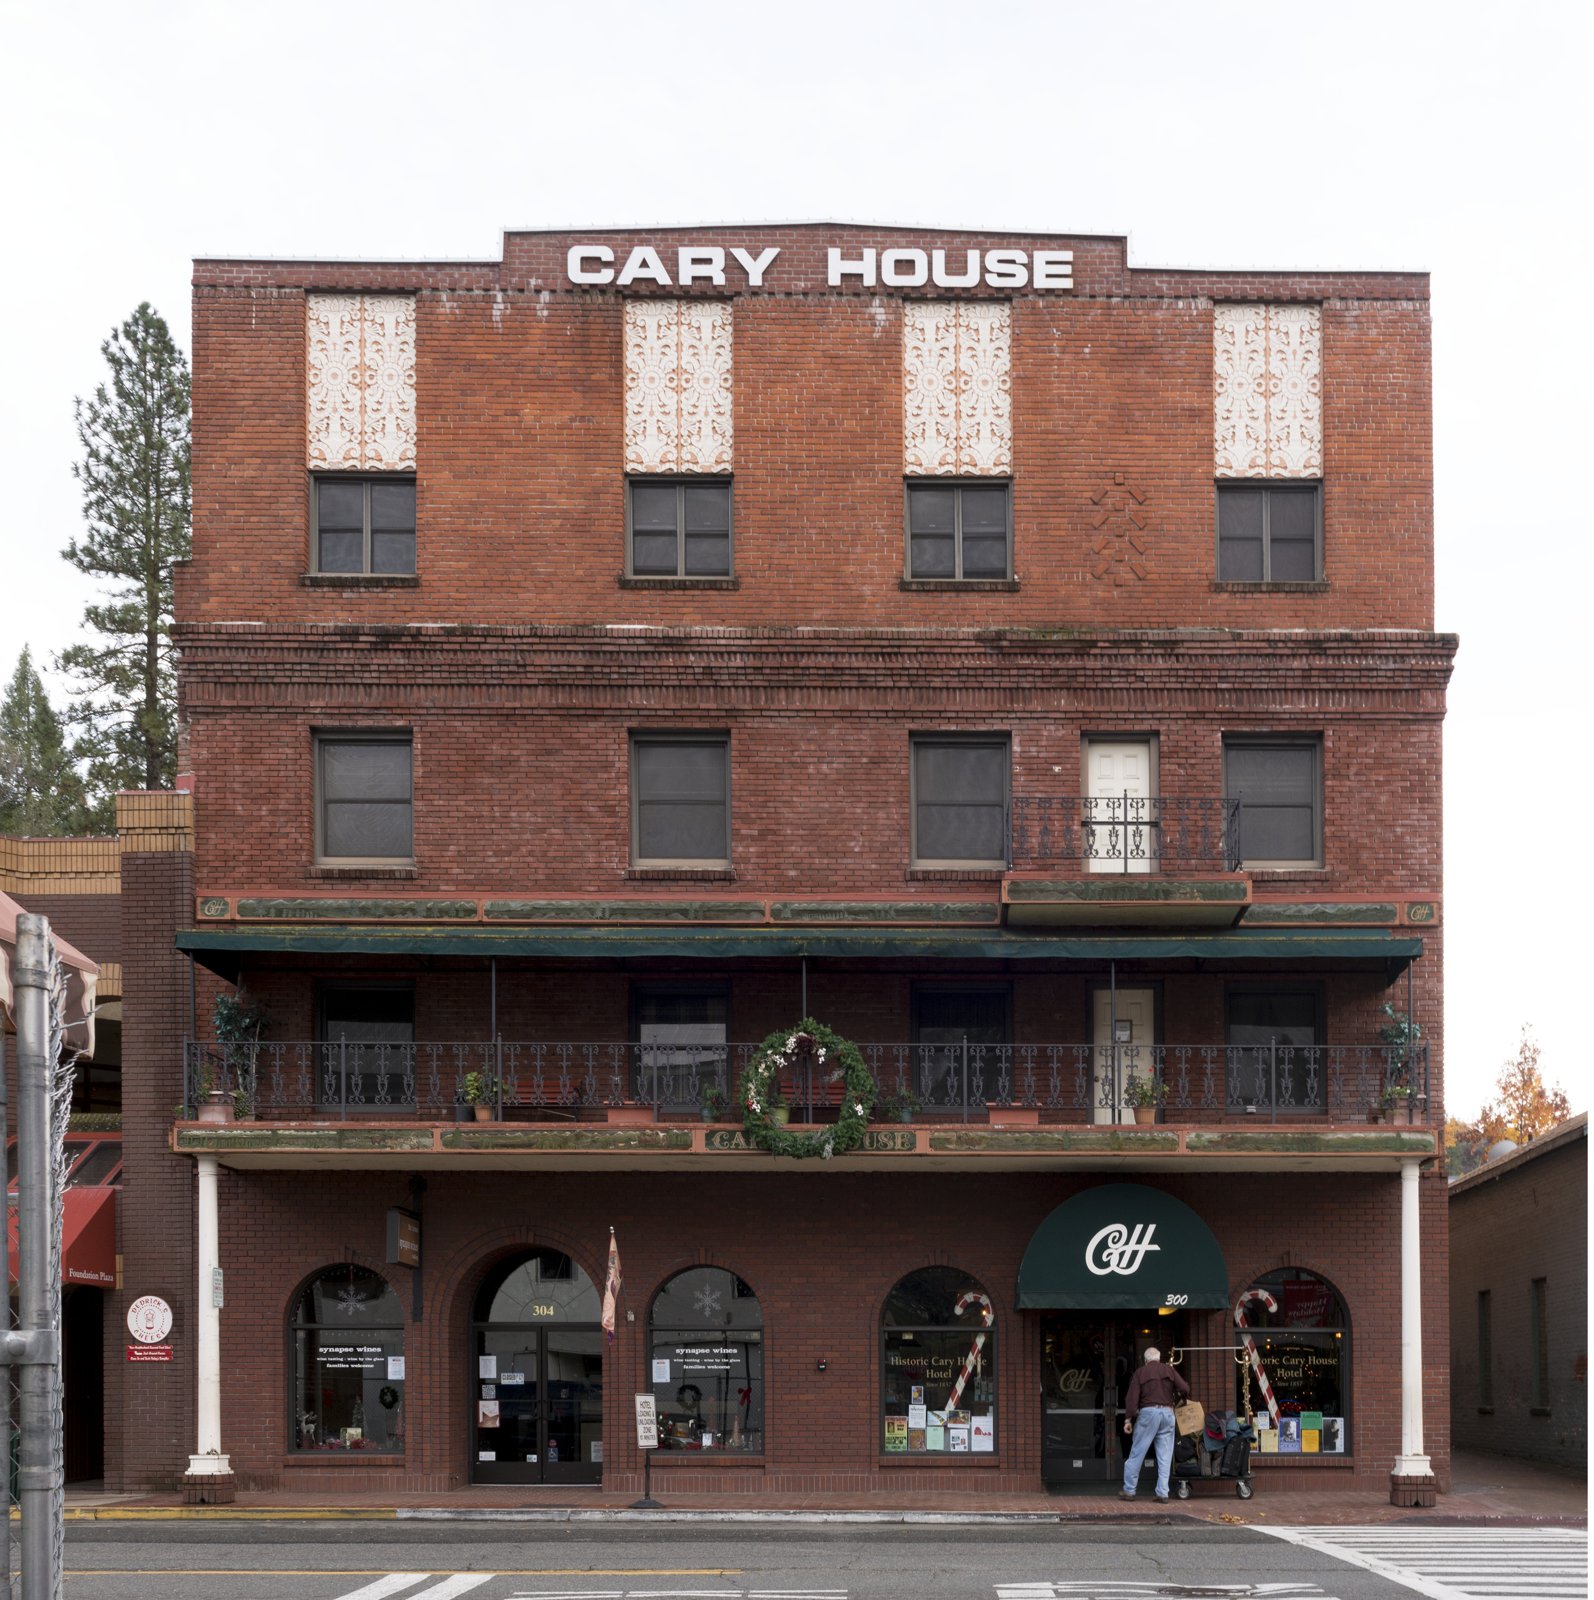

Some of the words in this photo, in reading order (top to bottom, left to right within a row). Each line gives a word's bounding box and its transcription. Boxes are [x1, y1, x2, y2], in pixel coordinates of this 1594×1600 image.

[566, 245, 781, 287] CARY
[827, 247, 1074, 290] HOUSE
[711, 1130, 758, 1149] CA
[69, 1267, 99, 1280] Foundation
[1165, 1294, 1189, 1306] 300
[532, 1304, 554, 1317] 304
[133, 1329, 167, 1341] CHEESE
[319, 1346, 354, 1354] synapse
[890, 1356, 929, 1366] Historic
[931, 1356, 955, 1368] Cary
[1282, 1355, 1306, 1367] Cary
[1308, 1355, 1339, 1365] House
[926, 1369, 952, 1379] Hotel
[1277, 1368, 1303, 1378] Hotel
[640, 1400, 652, 1409] HOTEL
